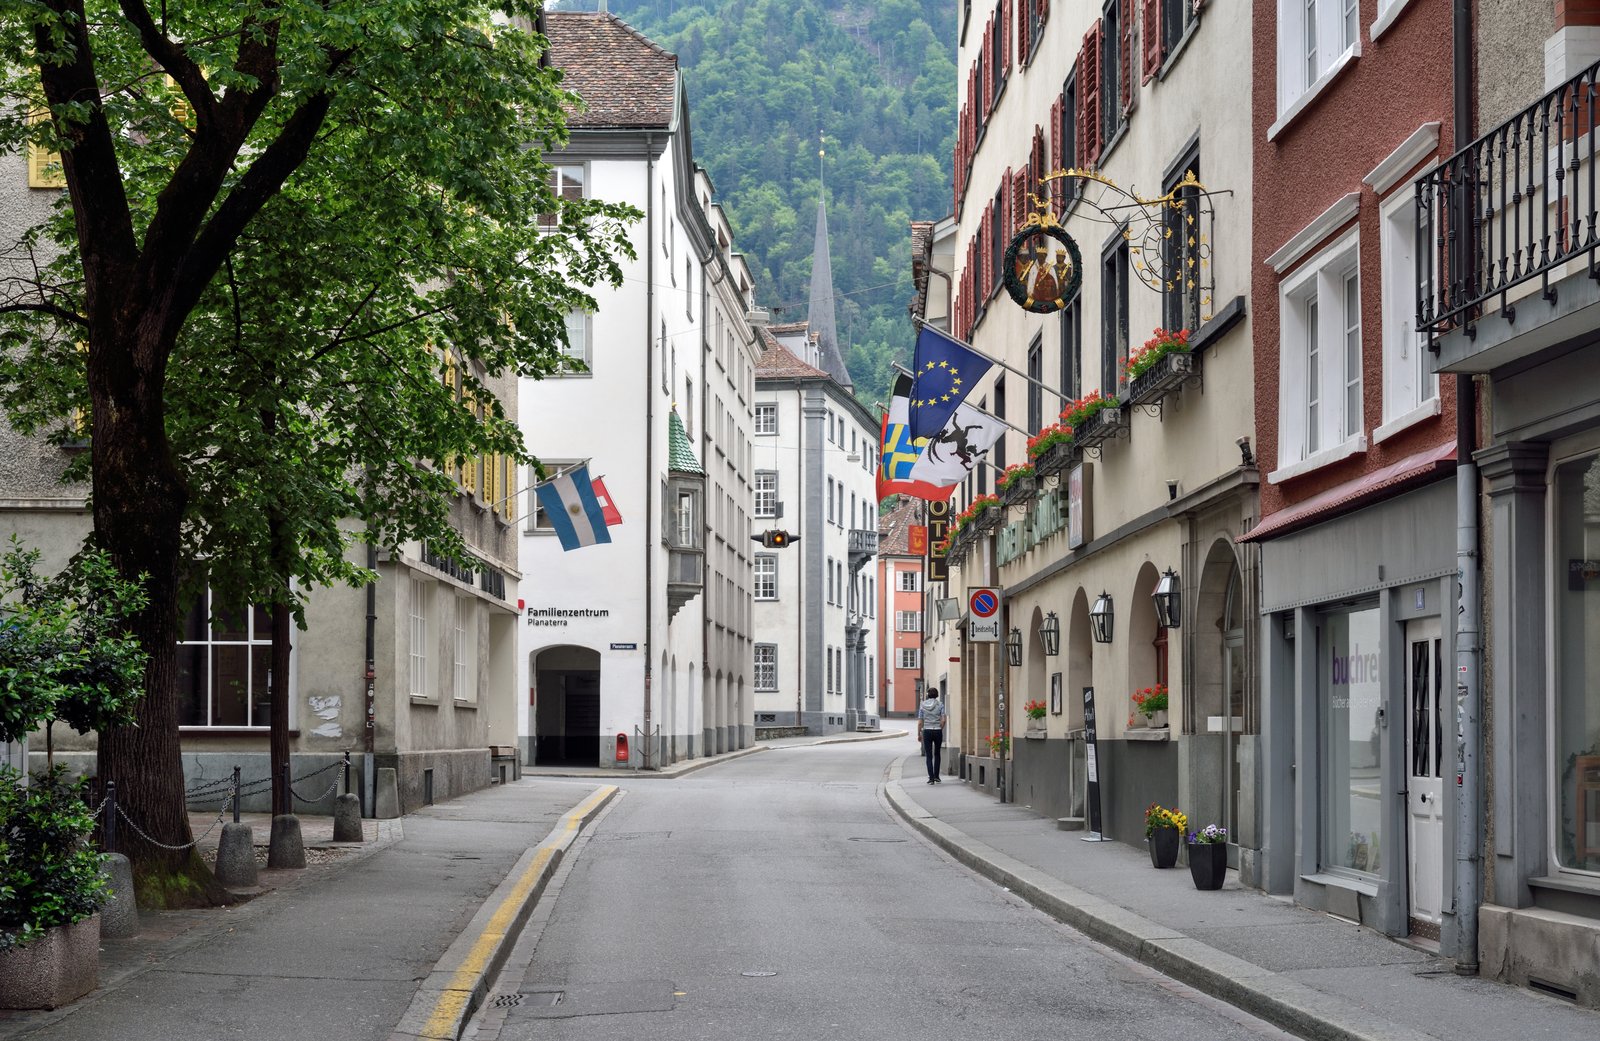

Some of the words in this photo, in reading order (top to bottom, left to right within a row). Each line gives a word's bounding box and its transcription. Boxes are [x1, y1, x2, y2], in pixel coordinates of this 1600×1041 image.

[930, 500, 948, 579] OTEL
[527, 607, 609, 617] Familienzentrum
[527, 618, 568, 627] Planaterra
